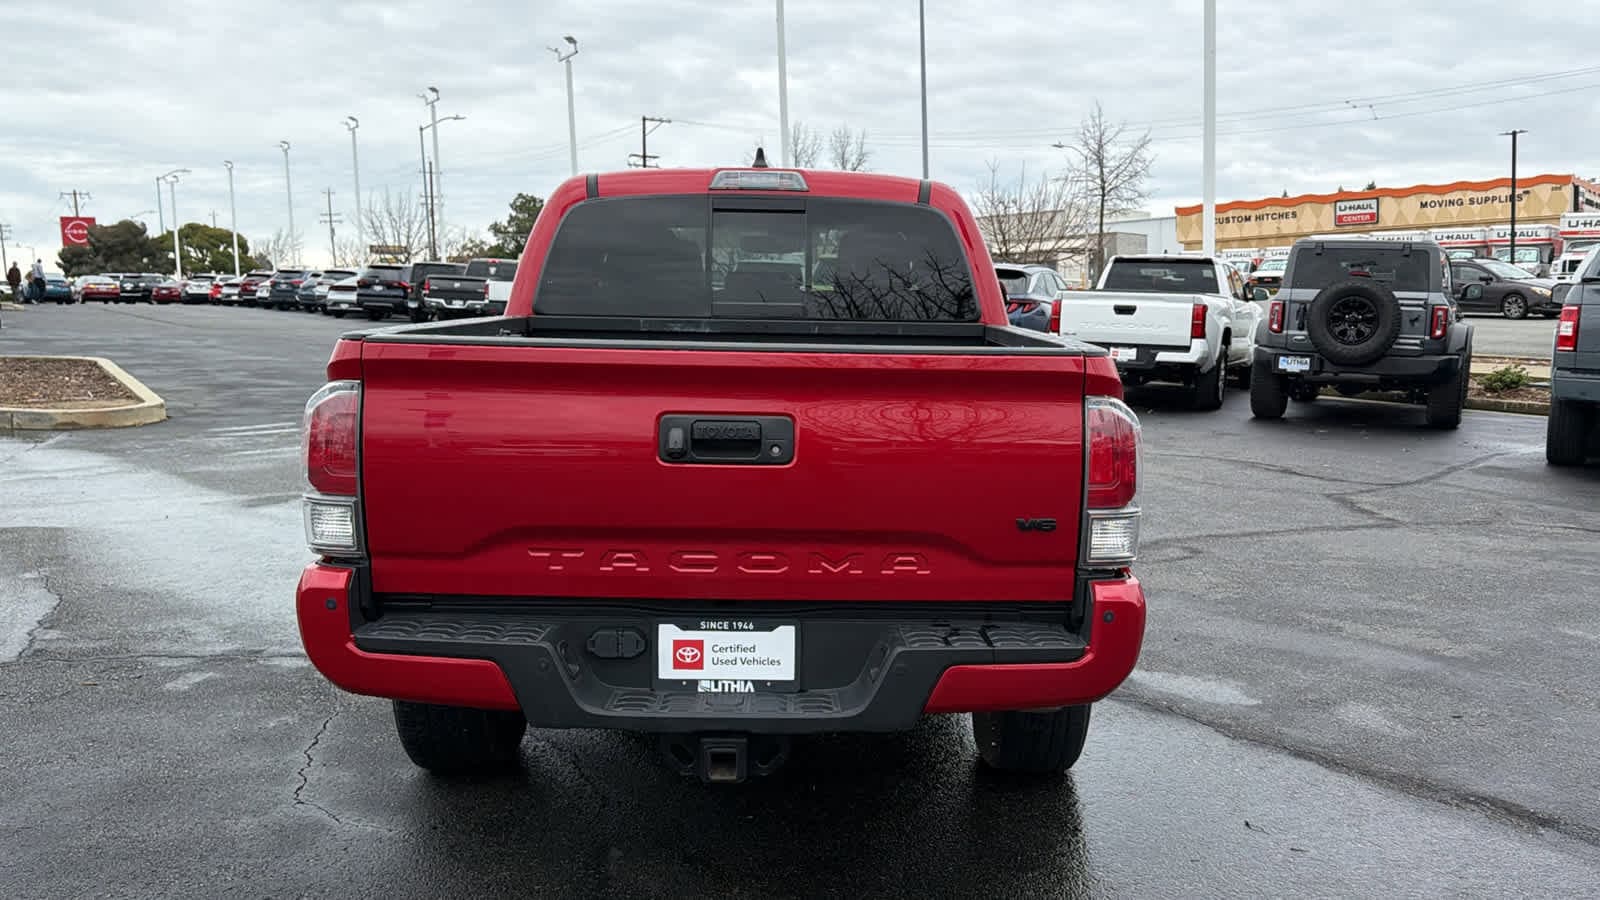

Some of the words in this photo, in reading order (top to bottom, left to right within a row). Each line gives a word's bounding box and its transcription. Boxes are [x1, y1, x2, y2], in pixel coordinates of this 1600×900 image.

[1339, 203, 1374, 211] U-HAUL
[1420, 199, 1464, 208] MOVING
[1255, 211, 1297, 221] HITCHES
[697, 426, 753, 437] TOYOTA
[1016, 518, 1056, 531] V6
[528, 548, 931, 575] TACOMA
[700, 621, 729, 630] SINCE
[732, 621, 754, 630] 1946
[711, 643, 756, 653] Certified
[711, 656, 737, 666] Used
[740, 656, 781, 666] Vehicles
[710, 680, 755, 692] LITHIA
